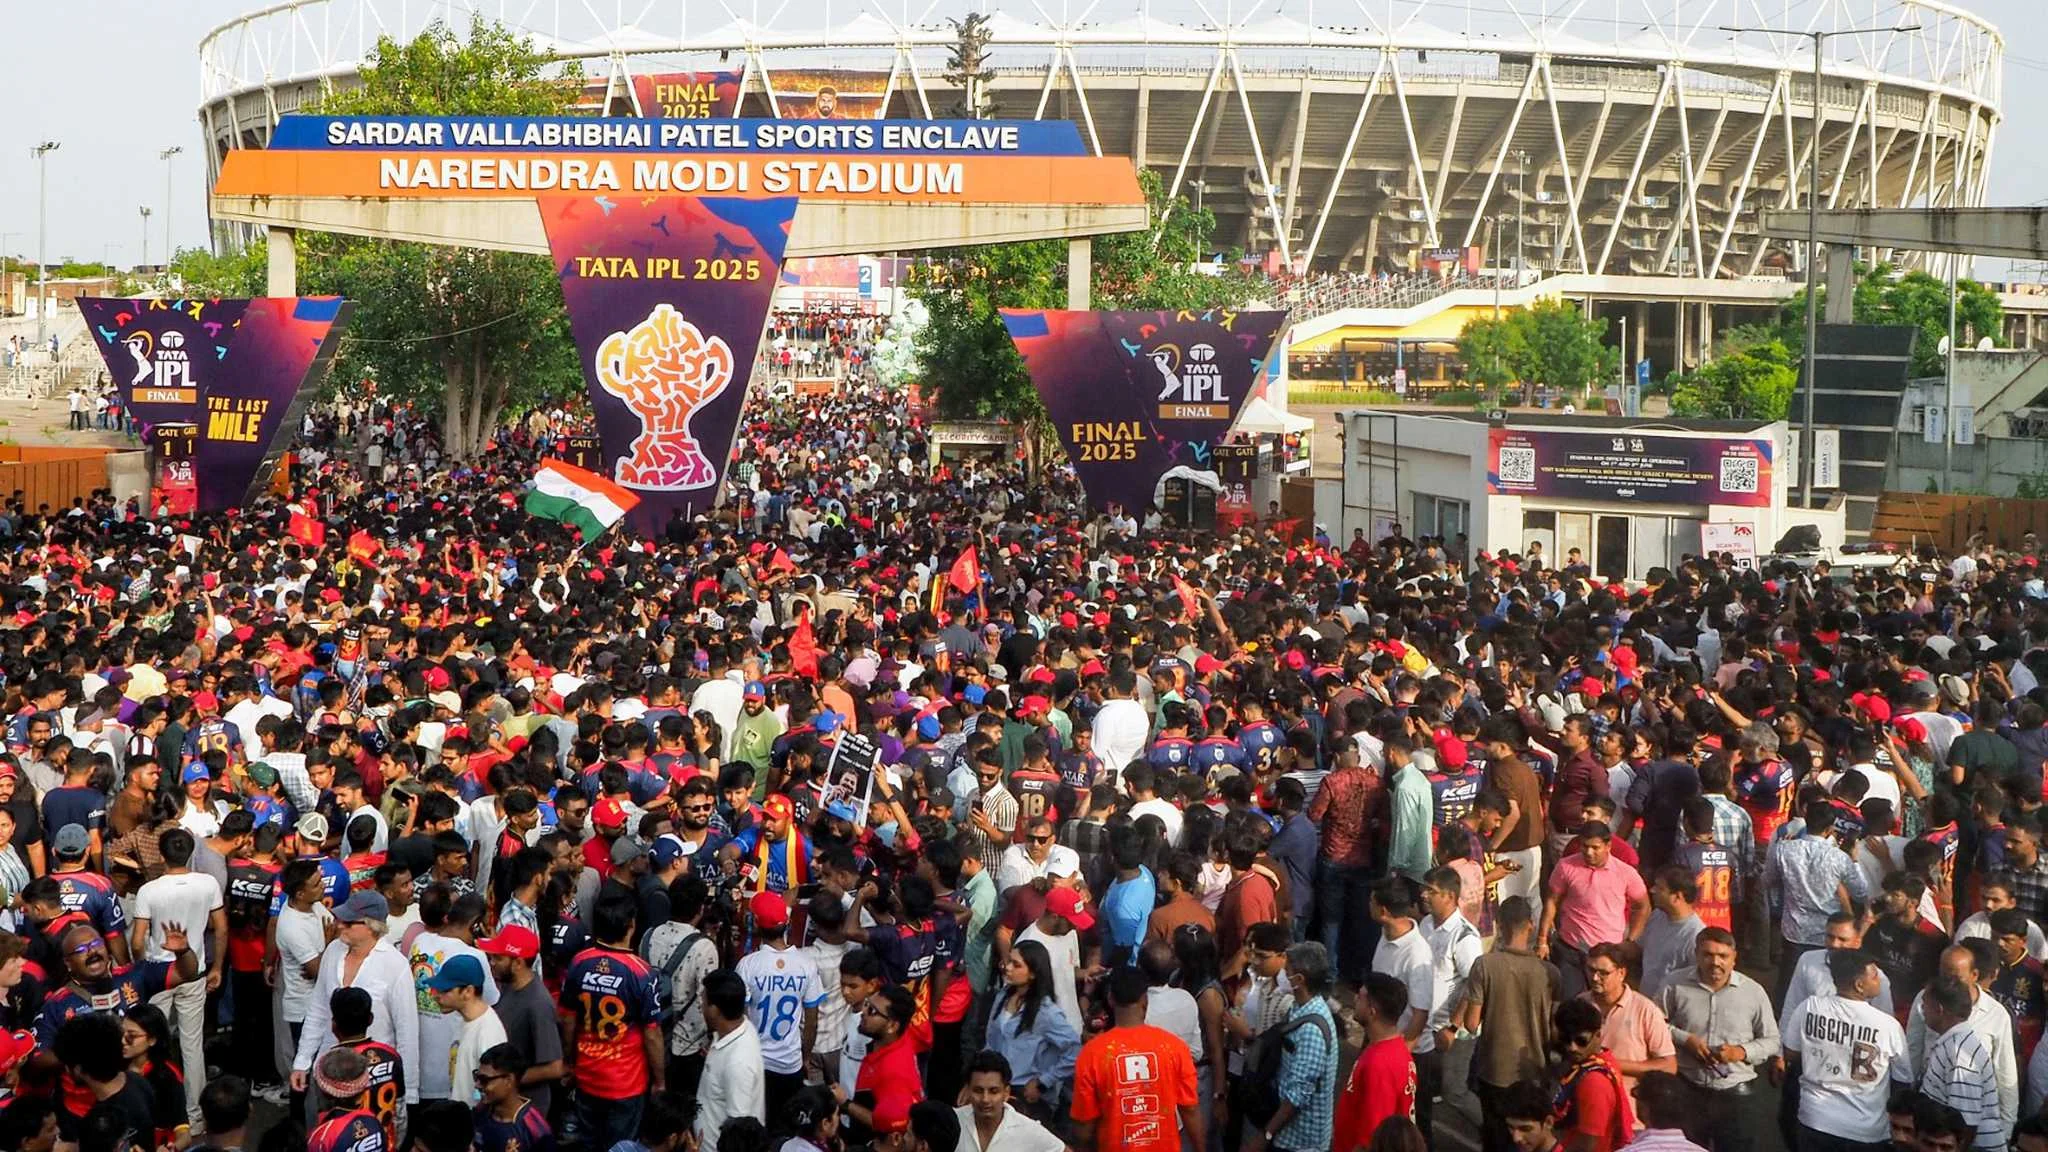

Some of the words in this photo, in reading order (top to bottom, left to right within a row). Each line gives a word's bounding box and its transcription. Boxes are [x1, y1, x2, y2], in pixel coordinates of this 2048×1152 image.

[656, 84, 720, 103] FINAL
[663, 104, 711, 119] 2025
[327, 121, 442, 145] SARDAR
[452, 123, 651, 147] VALLABHBHAI
[661, 125, 743, 148] PATEL
[757, 125, 873, 150] SPORTS
[882, 125, 1019, 149] ENCLAVE
[380, 158, 620, 190] NARENDRA
[633, 161, 748, 191] MODI
[763, 162, 963, 194] STADIUM
[575, 257, 639, 278] TATA
[646, 259, 685, 279] IPL
[693, 259, 761, 280] 2025
[860, 266, 871, 283] 2
[157, 350, 188, 360] TATA
[154, 360, 197, 387] IPL
[1185, 363, 1219, 374] TATA
[147, 390, 181, 402] FINAL
[1183, 375, 1229, 401] IPL
[207, 397, 230, 410] THE
[237, 399, 268, 413] LAST
[1175, 407, 1213, 417] FINAL
[158, 428, 179, 437] GATE
[207, 411, 261, 442] MILE
[1072, 421, 1147, 443] FINAL
[164, 441, 171, 456] 1
[187, 440, 193, 454] 1
[570, 439, 593, 449] GATE
[576, 451, 584, 467] 1
[1080, 444, 1136, 461] 2025
[178, 470, 193, 481] IPL
[1218, 462, 1224, 476] 1
[1241, 461, 1248, 476] 1
[1063, 770, 1084, 783] ATAR
[1441, 782, 1477, 798] KEI
[1020, 793, 1045, 817] 18
[1702, 851, 1727, 860] KEI
[231, 879, 272, 894] KEI
[1696, 867, 1731, 904] 18
[60, 893, 88, 905] EI
[582, 972, 623, 988] KEI
[755, 976, 806, 992] VIRAT
[579, 992, 628, 1040] 18
[756, 994, 800, 1041] 18
[1125, 1055, 1150, 1081] R
[1851, 1041, 1880, 1081] B
[1133, 1104, 1147, 1112] DAY
